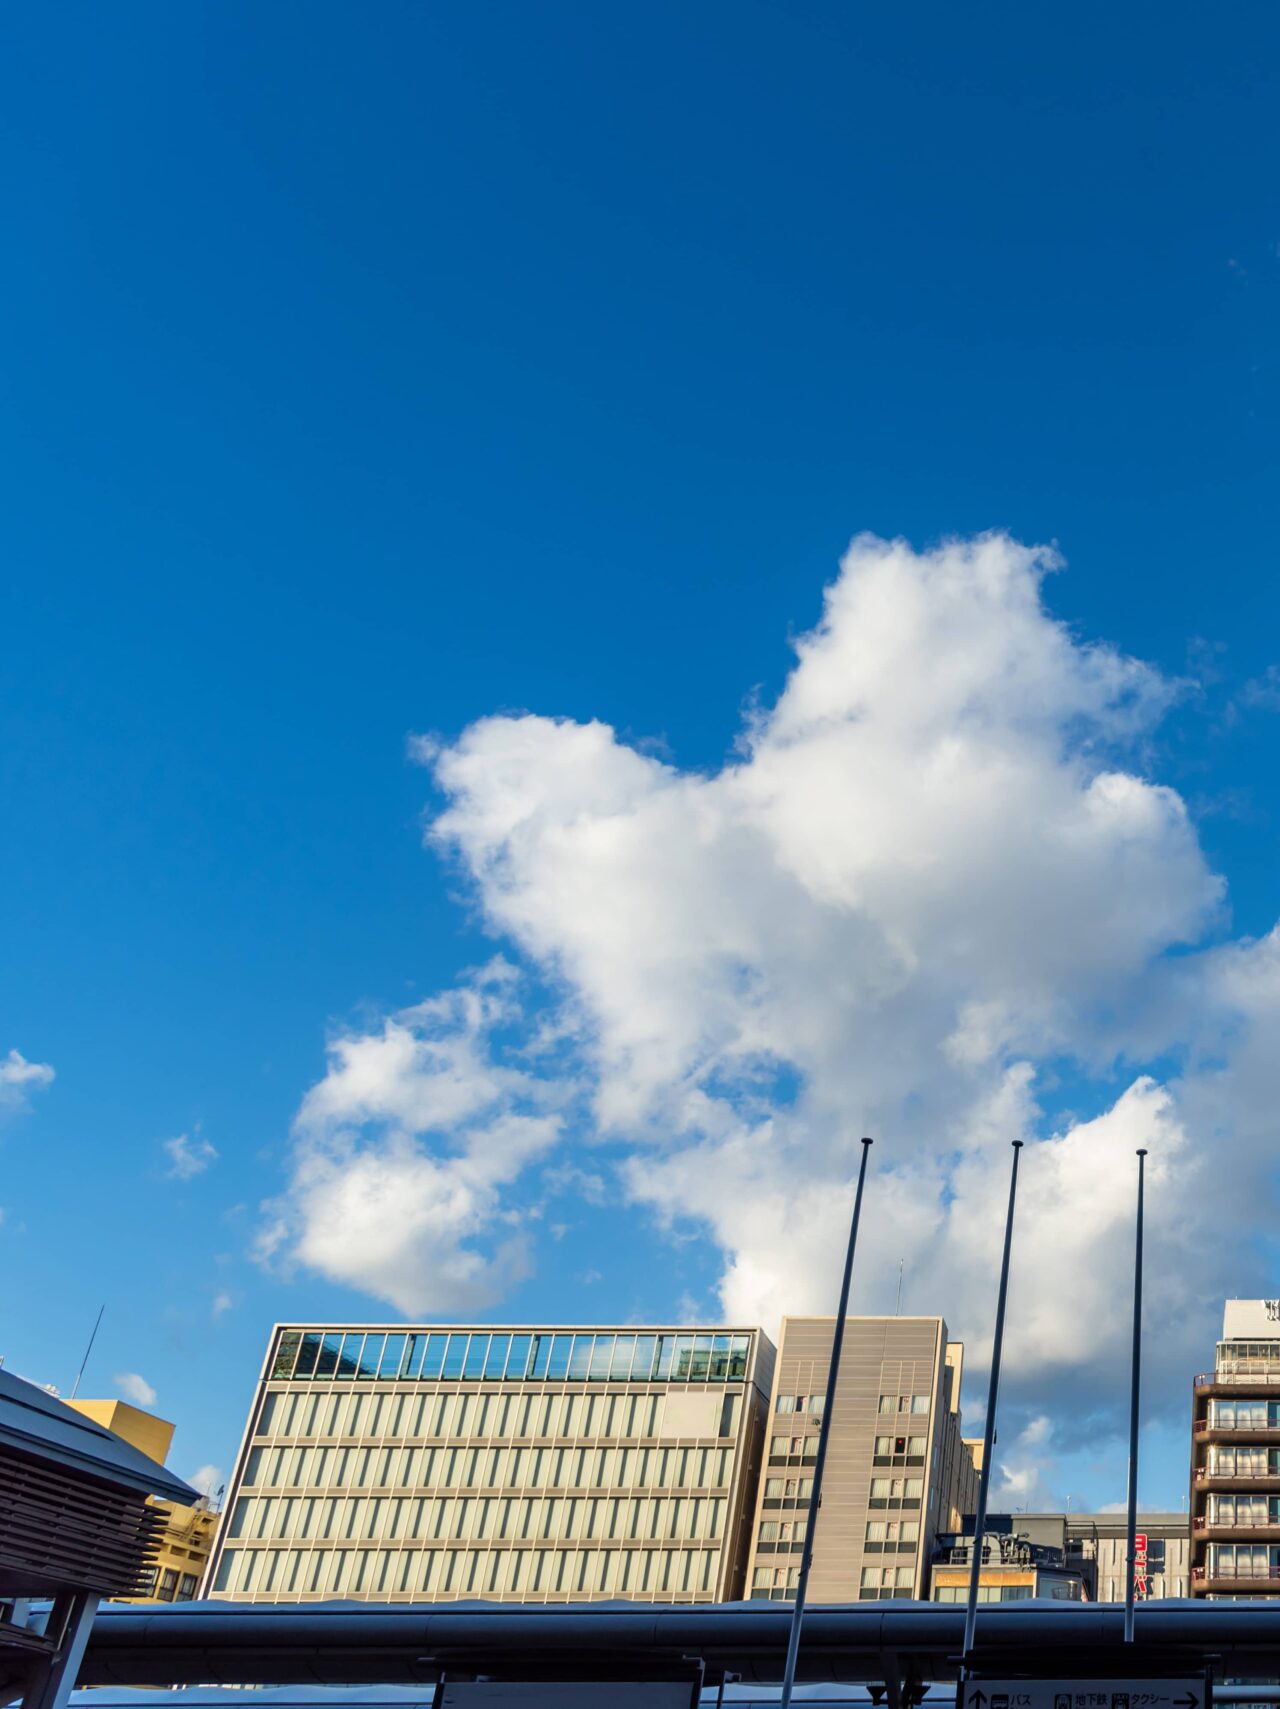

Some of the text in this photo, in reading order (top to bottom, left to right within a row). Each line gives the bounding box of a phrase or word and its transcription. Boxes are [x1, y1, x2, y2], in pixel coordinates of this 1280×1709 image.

[1010, 1694, 1031, 1706] バス
[1075, 1693, 1107, 1706] 地下鉄
[1131, 1694, 1169, 1705] タクシー
